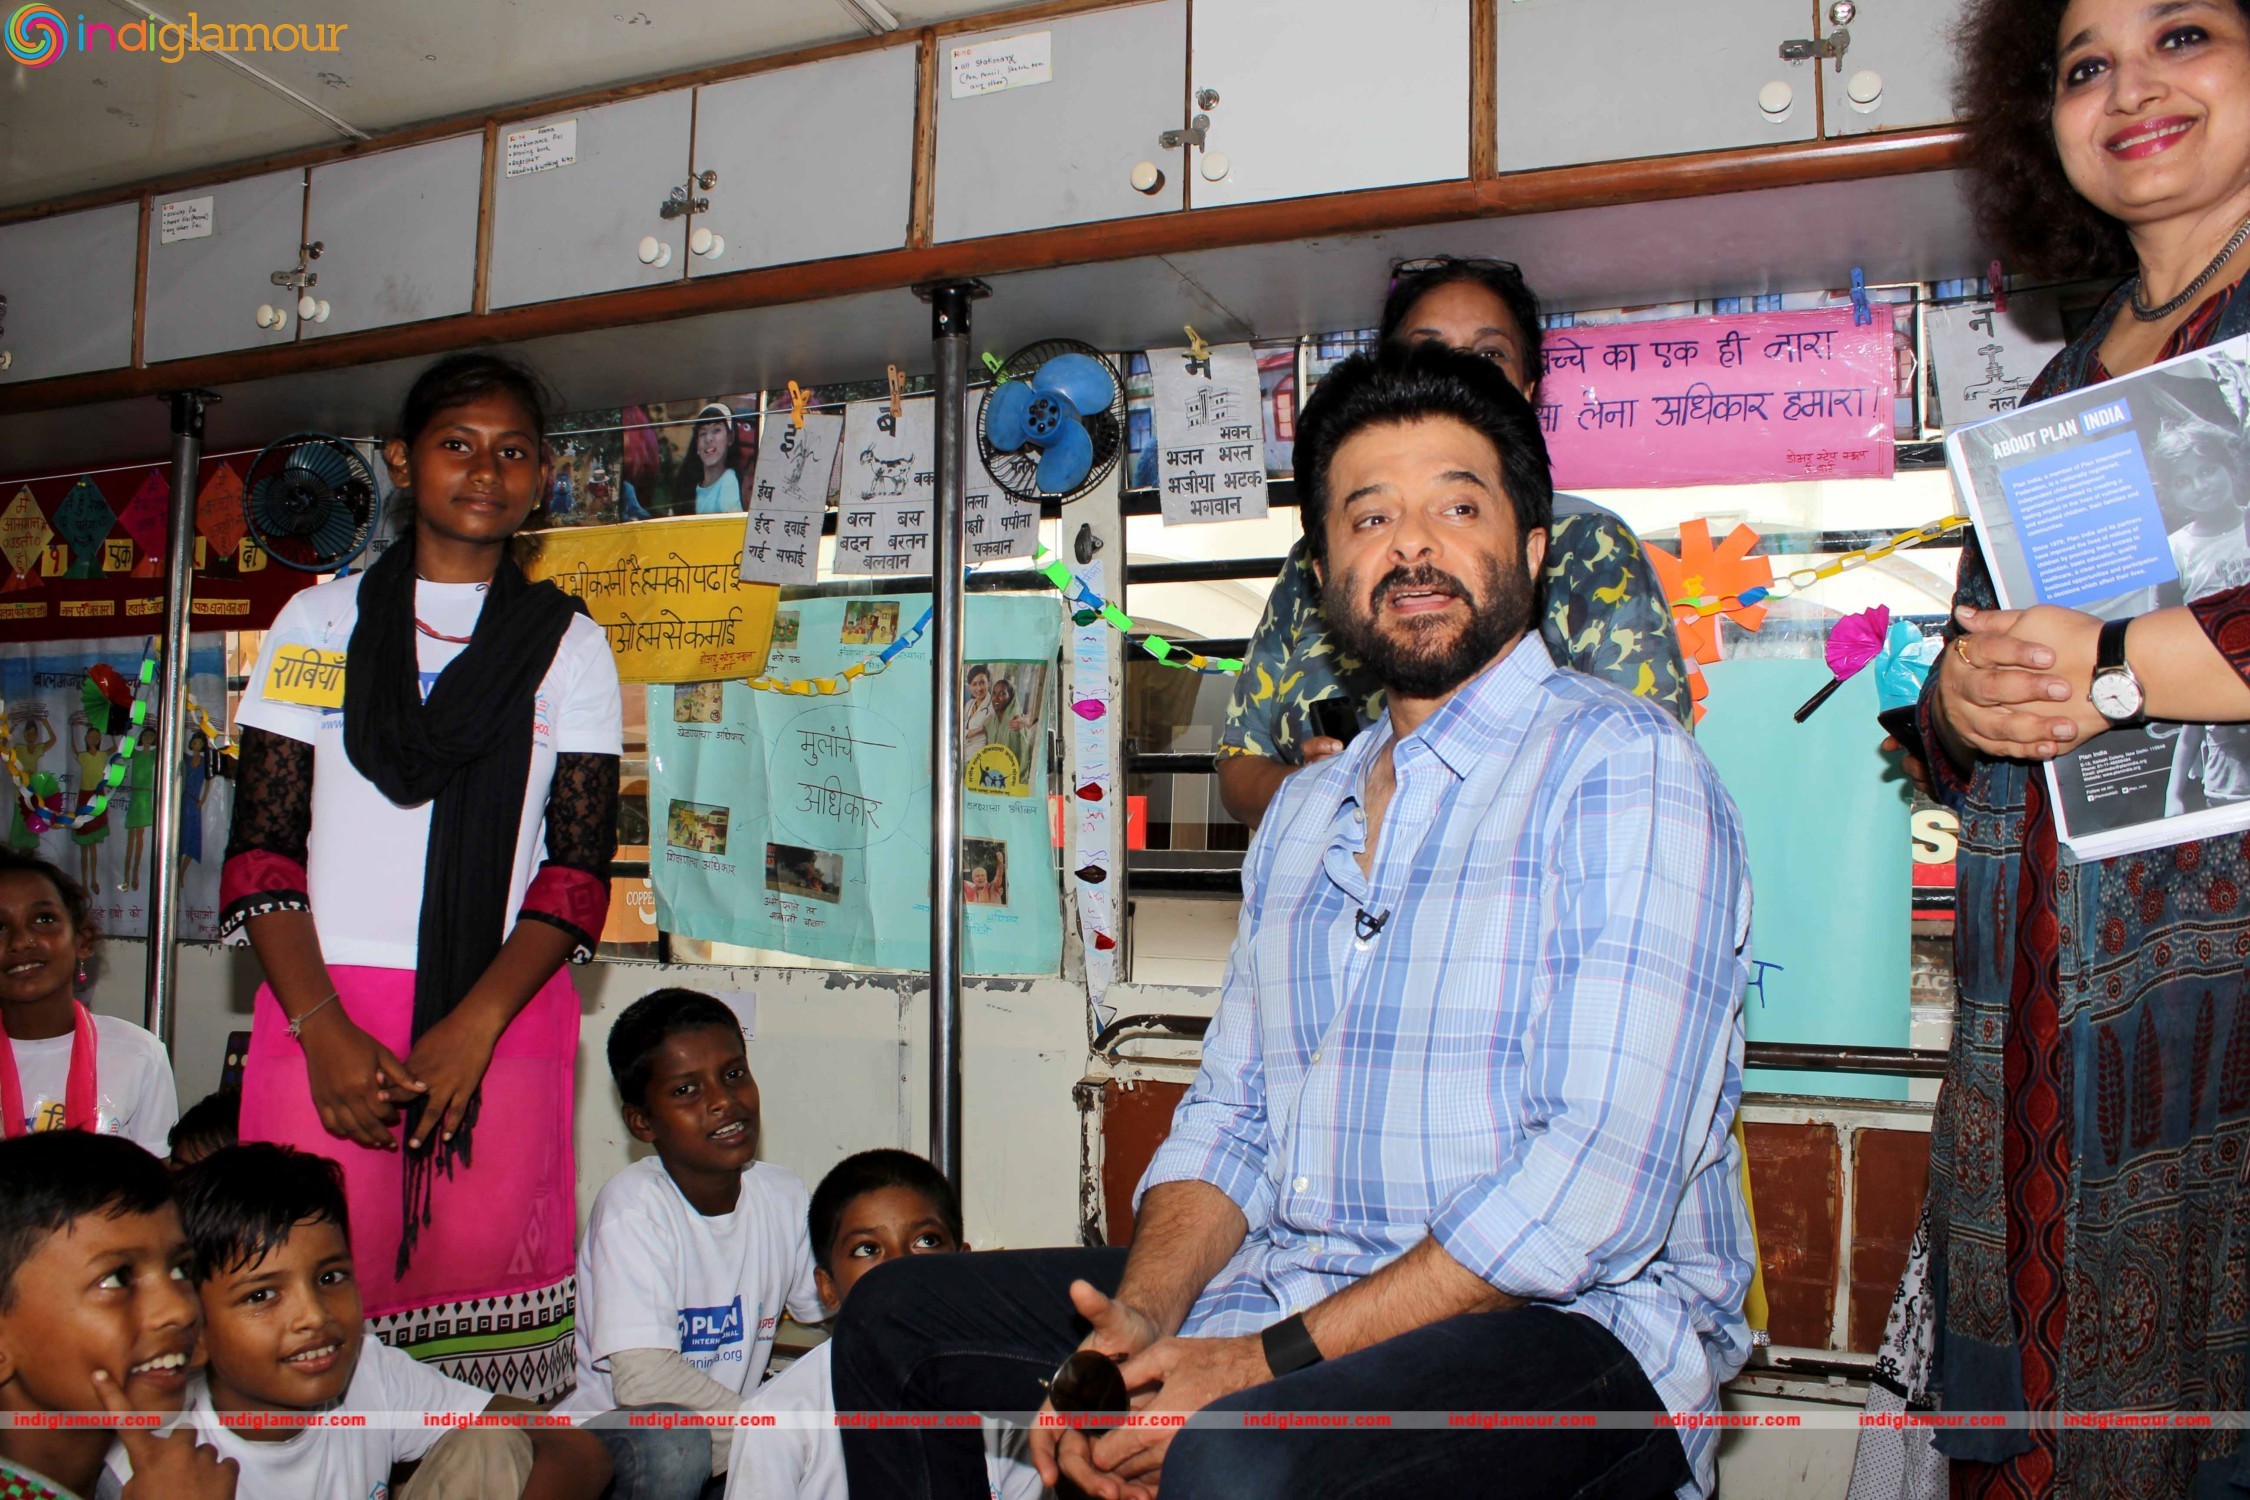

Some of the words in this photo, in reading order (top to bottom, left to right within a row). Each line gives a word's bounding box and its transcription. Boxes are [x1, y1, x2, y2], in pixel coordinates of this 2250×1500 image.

[1603, 343, 1641, 372] का
[1650, 341, 1699, 368] एक
[1717, 330, 1751, 368] ही
[1764, 330, 1838, 363] नारा
[1652, 382, 1774, 427] अधिकार
[1220, 425, 1252, 440] भवन
[1992, 432, 2036, 460] ABOUT
[2039, 419, 2078, 445] PLAN
[2083, 404, 2126, 431] INDIA
[1167, 448, 1204, 466] भजन
[1224, 470, 1262, 489] भटक
[1191, 496, 1242, 516] भगवान
[847, 512, 876, 528] बल
[897, 511, 925, 528] बस
[1001, 511, 1032, 531] पपीता
[888, 533, 928, 550] बरतन
[973, 540, 1014, 556] पकवान
[863, 554, 911, 570] बलवान
[796, 776, 882, 829] अधिकार
[702, 856, 736, 876] अधिकार
[692, 1307, 737, 1335] PLAN
